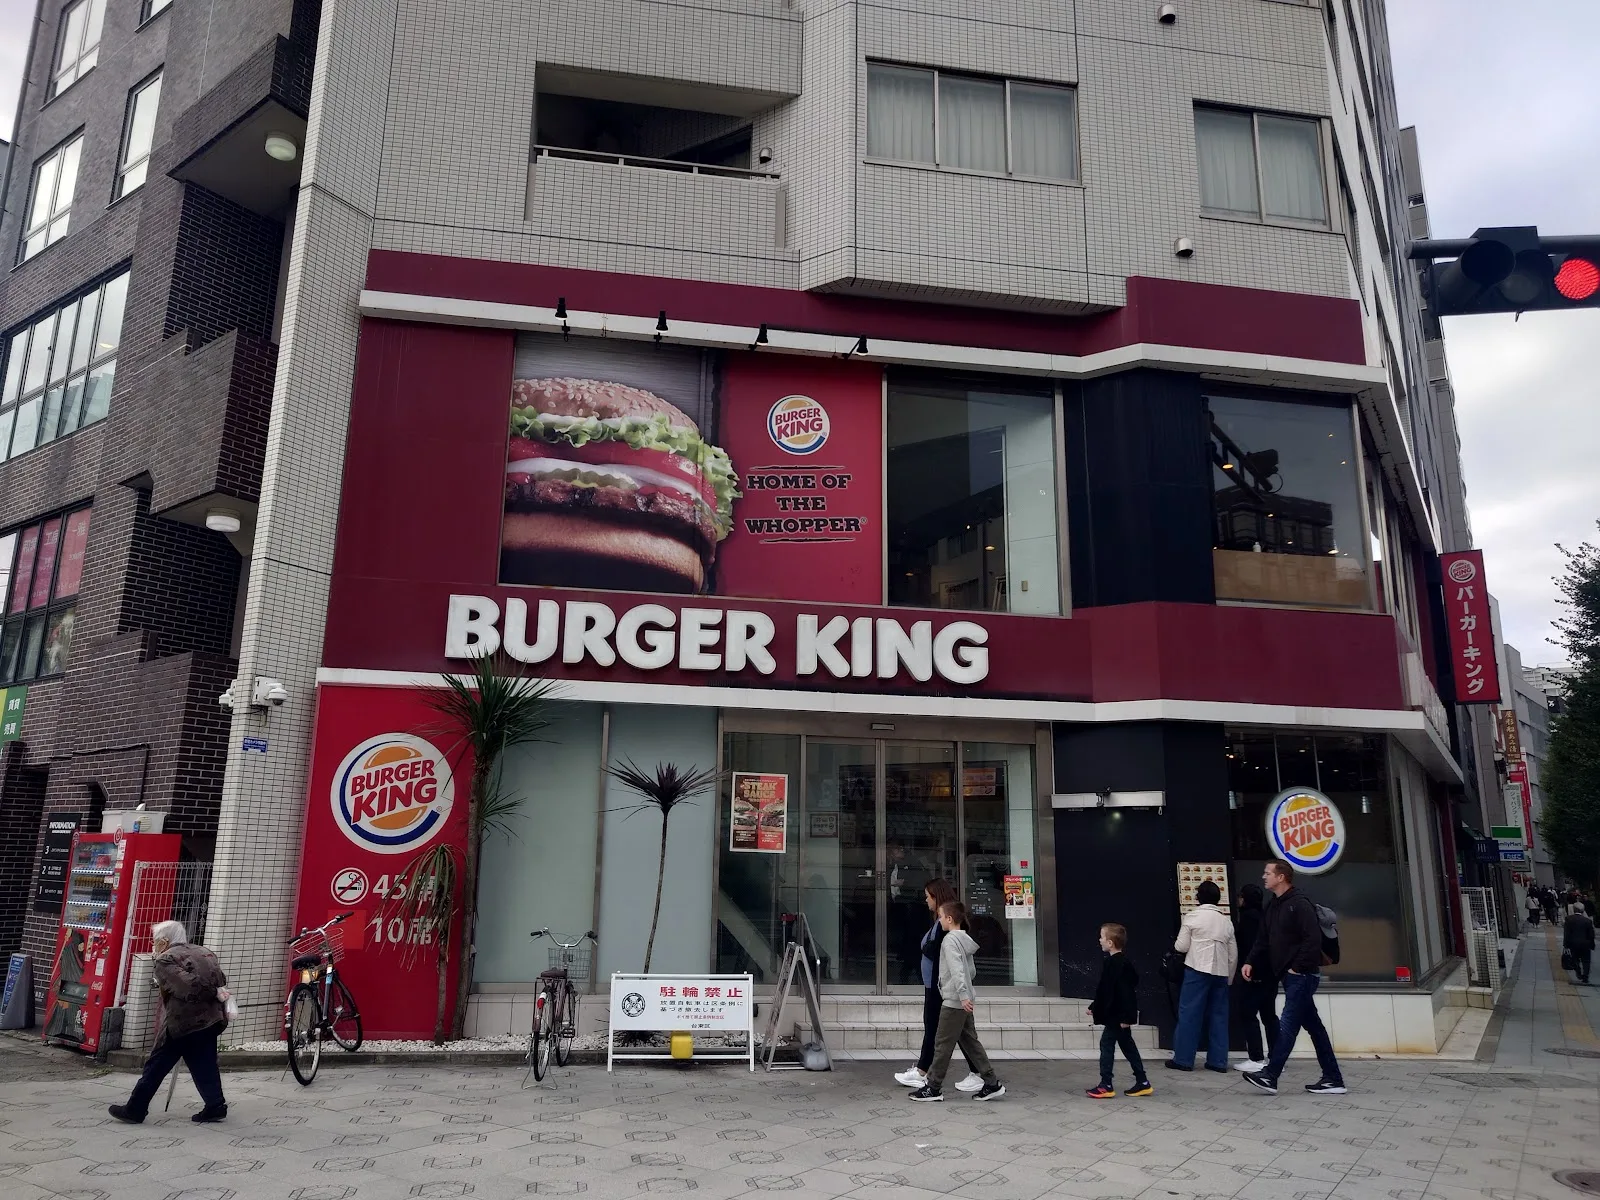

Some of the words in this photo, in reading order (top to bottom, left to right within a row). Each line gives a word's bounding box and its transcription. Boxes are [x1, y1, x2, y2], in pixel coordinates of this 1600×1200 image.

[775, 407, 821, 426] BURGER
[777, 417, 823, 440] KING
[747, 474, 816, 489] HOME
[821, 474, 851, 489] OF
[776, 496, 826, 511] THE
[745, 517, 862, 533] WHOPPER
[1453, 564, 1470, 573] BURGER
[1453, 567, 1472, 577] KING
[444, 594, 777, 675] BURGER
[796, 613, 989, 684] KING
[1457, 585, 1484, 695] バーガーキング
[351, 759, 435, 797] BURGER
[743, 781, 777, 790] STEAK
[352, 777, 438, 824] KING
[744, 790, 776, 798] SAUCE
[1280, 805, 1331, 833] BURGER
[1284, 819, 1336, 852] KING
[660, 986, 743, 998] 駐輪禁止
